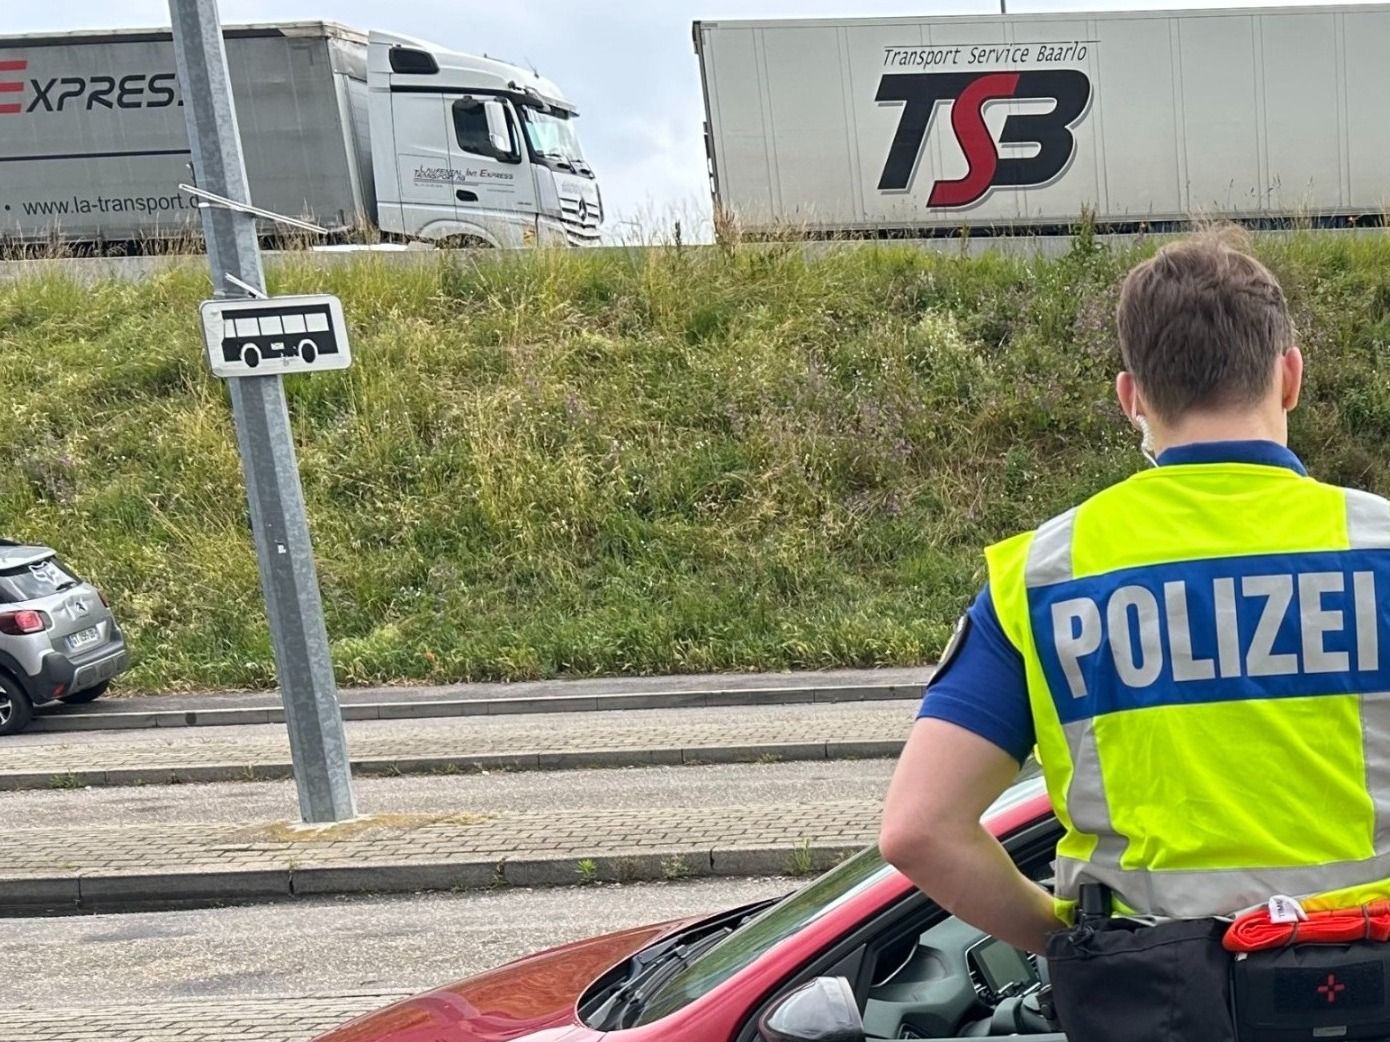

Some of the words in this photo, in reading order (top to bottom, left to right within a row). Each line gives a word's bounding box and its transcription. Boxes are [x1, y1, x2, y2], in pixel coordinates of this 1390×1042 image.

[0, 59, 184, 113] EXPRES
[883, 47, 961, 69] Transport
[968, 42, 1029, 64] Service
[1036, 41, 1088, 62] Baarlo
[875, 69, 1093, 211] TSB
[1051, 571, 1379, 699] POLIZEI
